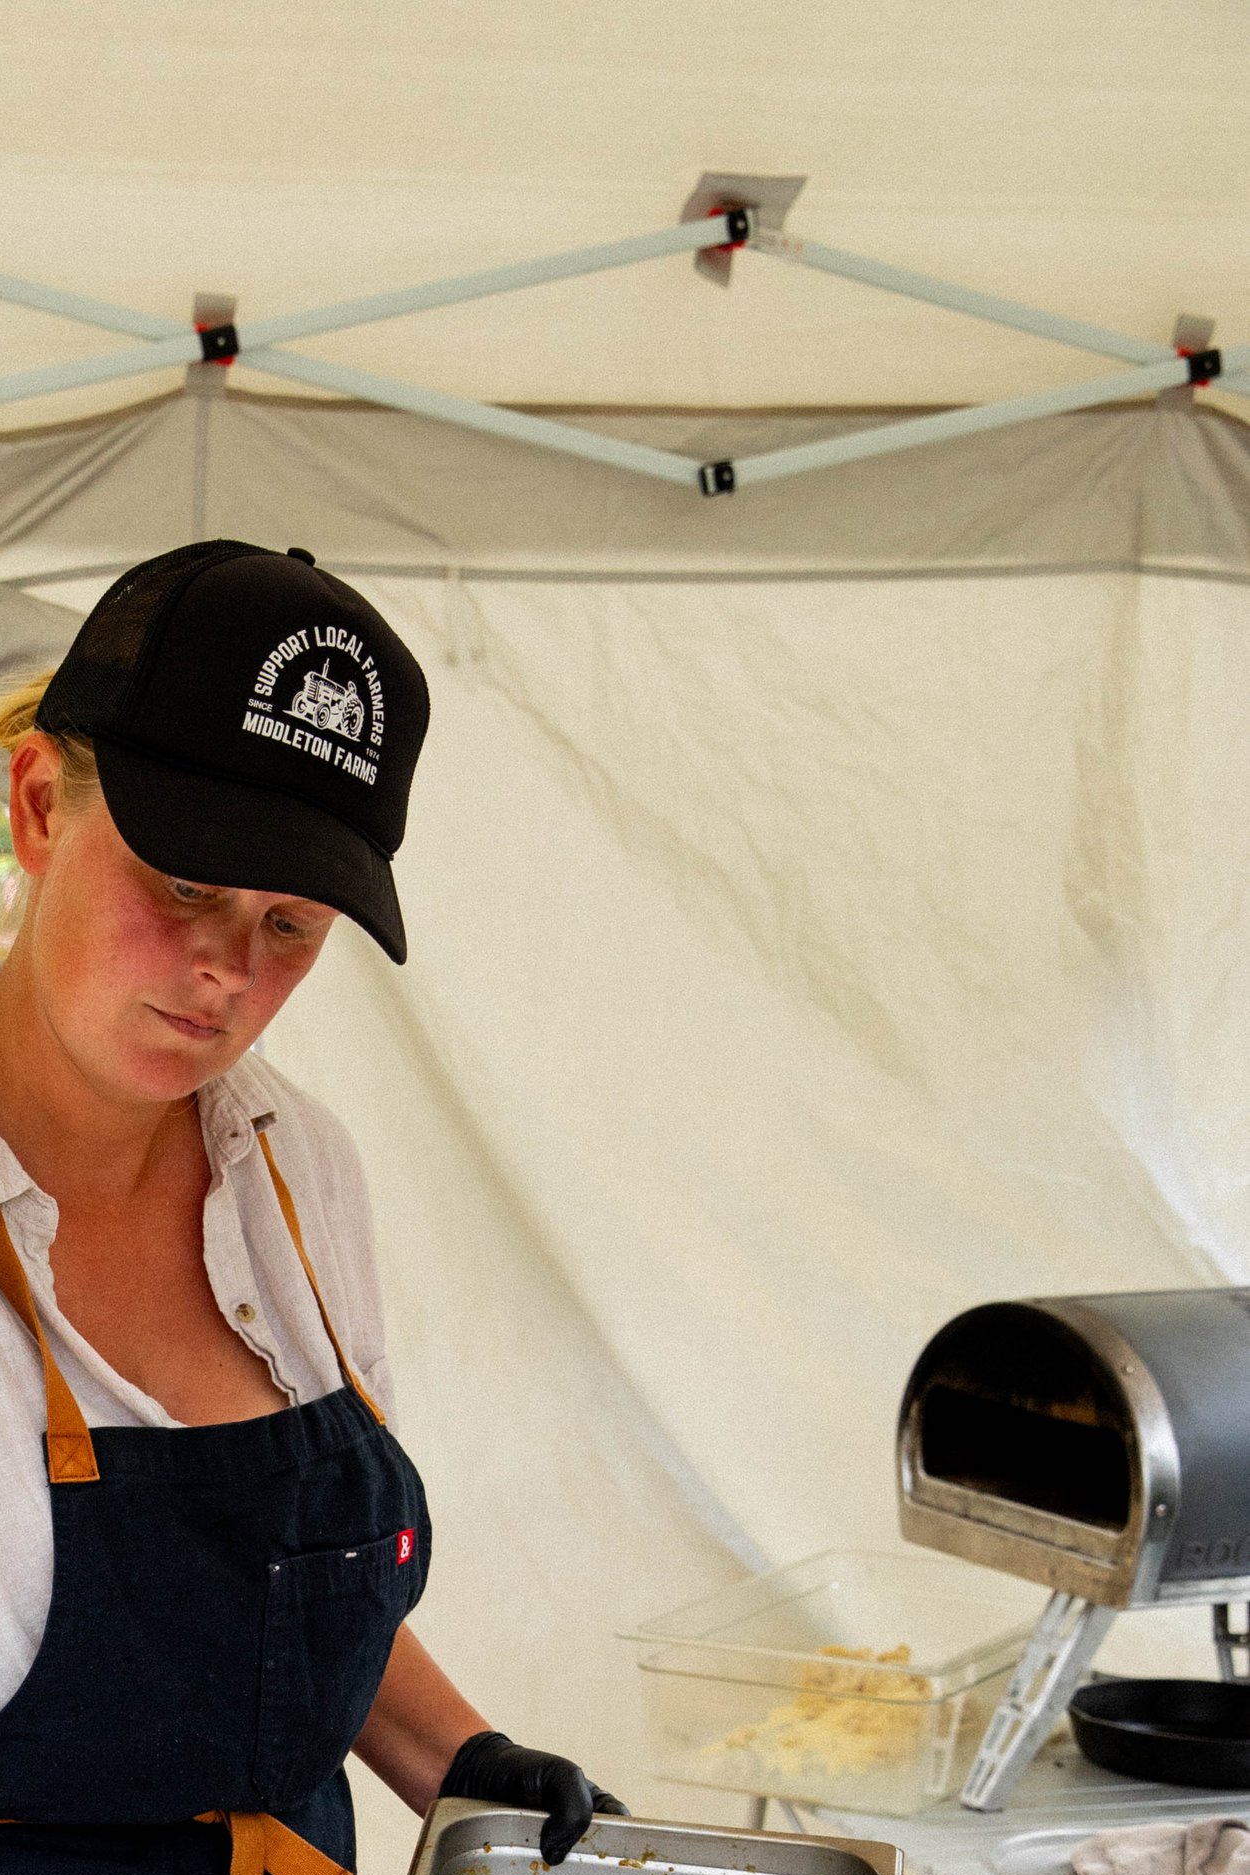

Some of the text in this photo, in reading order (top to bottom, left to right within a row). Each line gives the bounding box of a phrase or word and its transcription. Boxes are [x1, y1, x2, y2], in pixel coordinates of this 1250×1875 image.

[254, 626, 385, 746] SUPPORT LOCAL FARMERS
[242, 711, 378, 786] MIDDLETON FARMS
[248, 698, 380, 761] SINCE 1974
